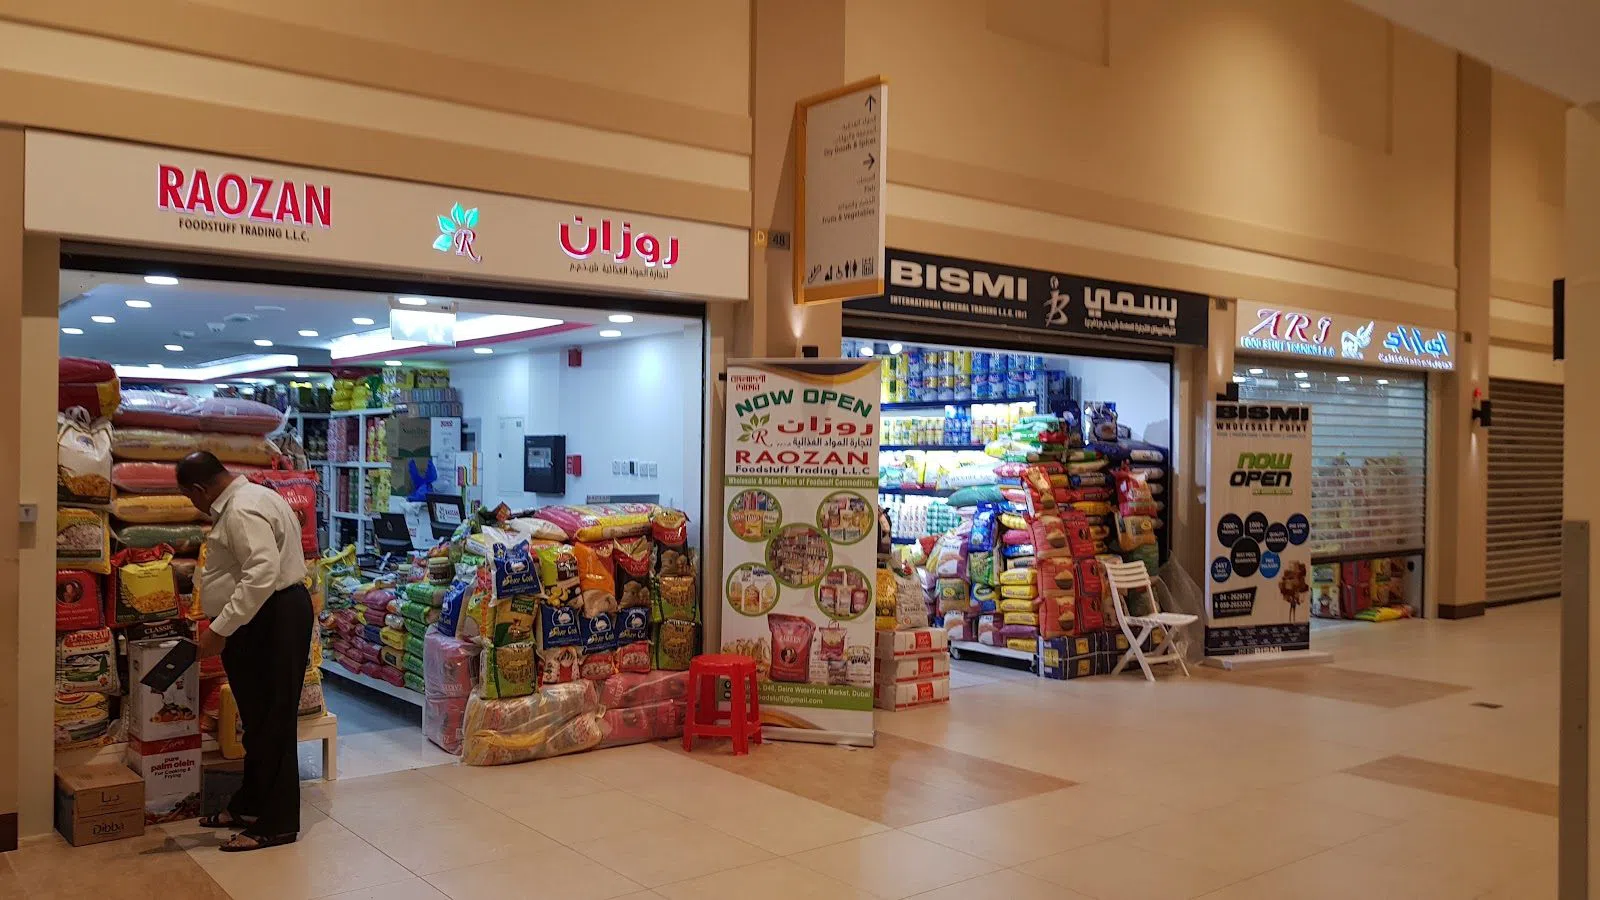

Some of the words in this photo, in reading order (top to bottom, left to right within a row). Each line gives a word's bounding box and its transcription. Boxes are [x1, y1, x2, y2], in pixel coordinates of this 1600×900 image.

[157, 163, 331, 228] RAOZAN
[179, 217, 237, 234] FOODSTUFF
[239, 223, 282, 240] TRADING
[558, 215, 680, 268] روزان
[890, 259, 1028, 302] BISMI
[890, 295, 941, 311] INTERNATIONAL
[942, 301, 970, 312] GENERAL
[970, 303, 998, 316] TRADING
[1084, 286, 1178, 327] بسمي
[735, 388, 794, 418] NOW
[803, 388, 873, 418] OPEN
[1216, 405, 1309, 421] BISMI
[777, 415, 874, 436] روزان
[1216, 422, 1274, 432] WHOLESALE
[1279, 423, 1307, 432] POINT
[823, 437, 849, 449] المواد
[849, 437, 872, 451] لتجارة
[735, 450, 870, 466] RAOZAN
[735, 464, 789, 475] Foodstuff
[793, 465, 839, 476] Trading
[728, 476, 757, 485] Wholesale
[763, 477, 782, 486] Retail
[782, 477, 799, 486] Point
[806, 478, 835, 487] Foodstuff
[143, 625, 174, 635] CLASSIC
[794, 686, 827, 696] Waterfront
[827, 688, 851, 698] Market,
[851, 689, 871, 699] Dubai
[150, 762, 173, 773] palm
[173, 759, 195, 769] olein
[164, 756, 179, 764] pure
[164, 767, 187, 776] Cooking
[164, 772, 182, 780] Frying
[92, 821, 125, 836] Dibba
